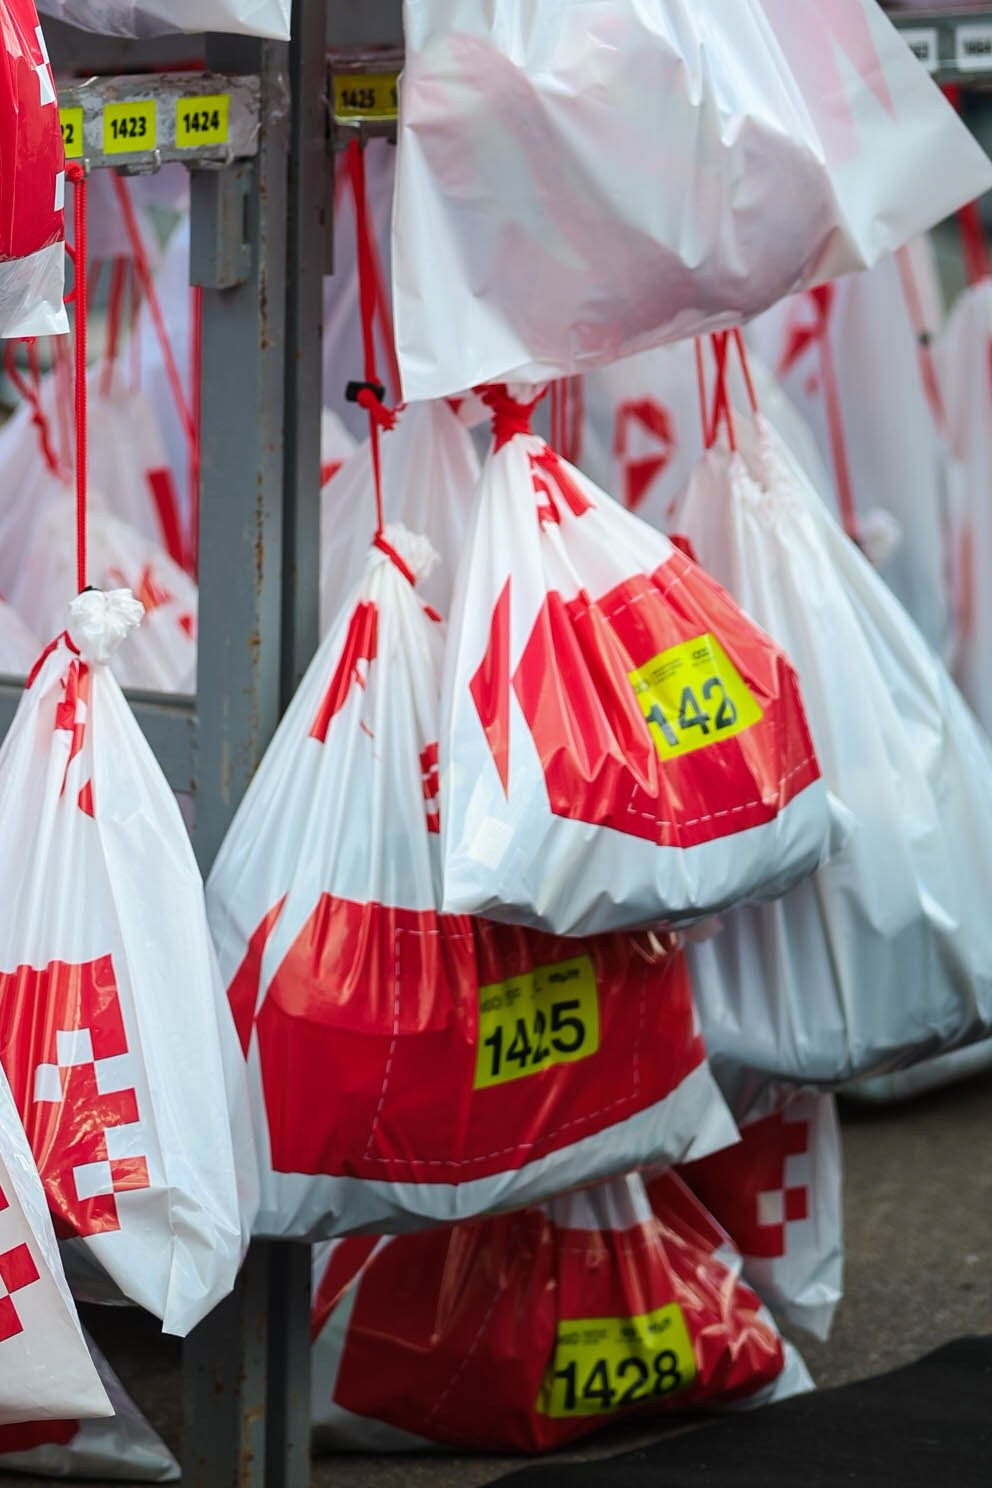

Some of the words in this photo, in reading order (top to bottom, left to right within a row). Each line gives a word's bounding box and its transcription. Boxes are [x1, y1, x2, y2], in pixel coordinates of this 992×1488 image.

[111, 116, 147, 140] 1423
[183, 110, 220, 134] 1424
[646, 676, 737, 746] 142
[484, 999, 585, 1076] 1425
[554, 1349, 681, 1410] 1428
